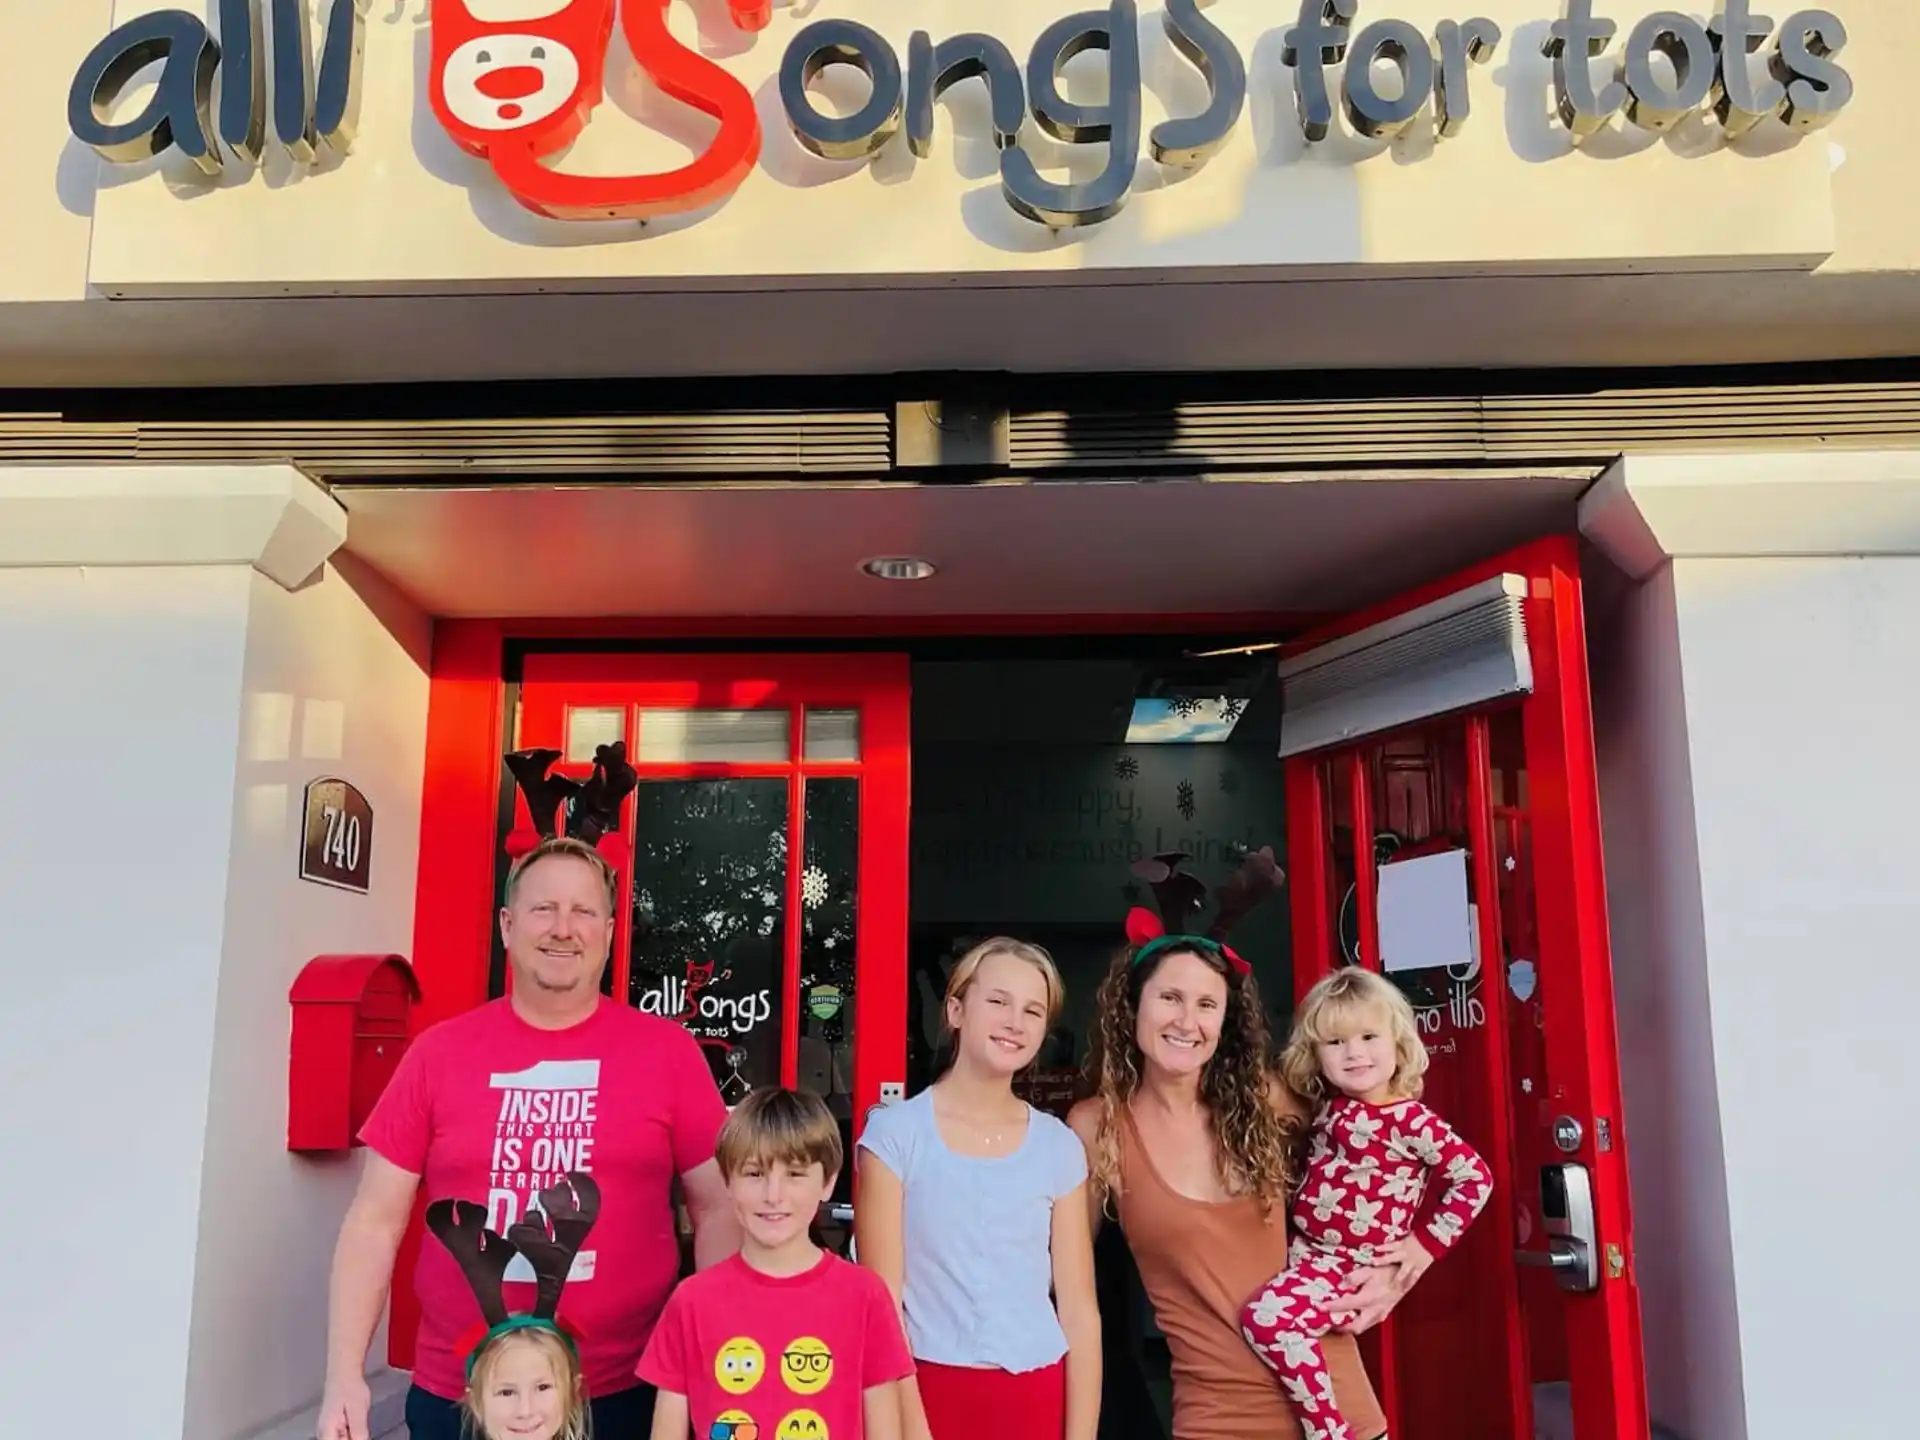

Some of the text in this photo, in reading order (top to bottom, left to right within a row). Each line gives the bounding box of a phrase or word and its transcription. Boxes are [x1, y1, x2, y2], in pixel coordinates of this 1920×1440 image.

[1280, 0, 1501, 140] for
[1540, 0, 1853, 135] tots
[323, 805, 360, 871] 740
[705, 1026, 729, 1037] tots
[499, 1090, 598, 1124] INSIDE
[496, 1123, 595, 1137] THIS SHIRT
[492, 1138, 595, 1172] IS ONE
[489, 1171, 565, 1189] TERRIF
